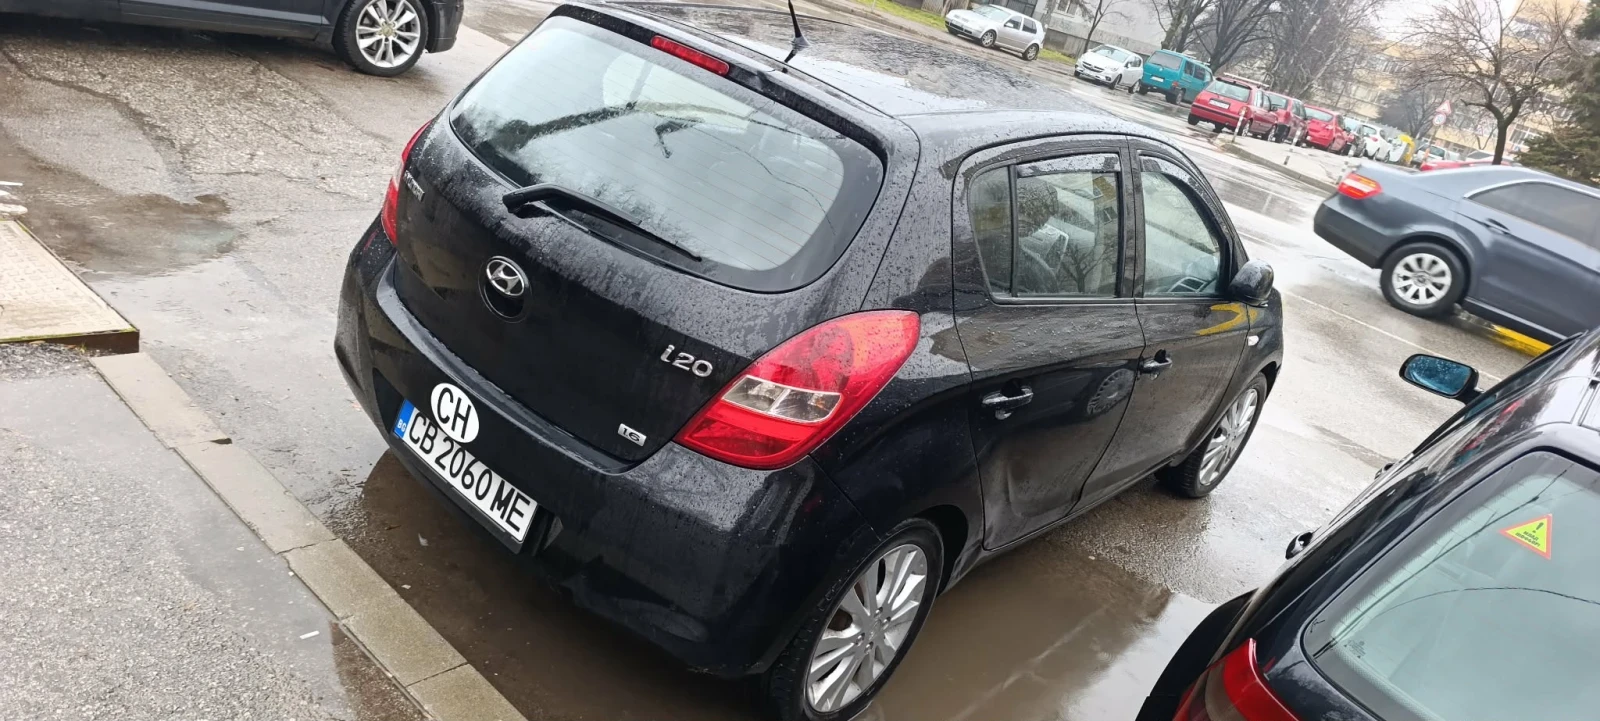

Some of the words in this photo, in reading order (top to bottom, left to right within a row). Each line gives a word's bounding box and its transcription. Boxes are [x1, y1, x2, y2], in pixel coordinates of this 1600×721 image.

[660, 344, 713, 377] i20
[397, 418, 407, 432] BG
[437, 387, 472, 439] CH
[408, 412, 438, 455] CB
[434, 437, 492, 501] 2060
[489, 480, 531, 533] ME
